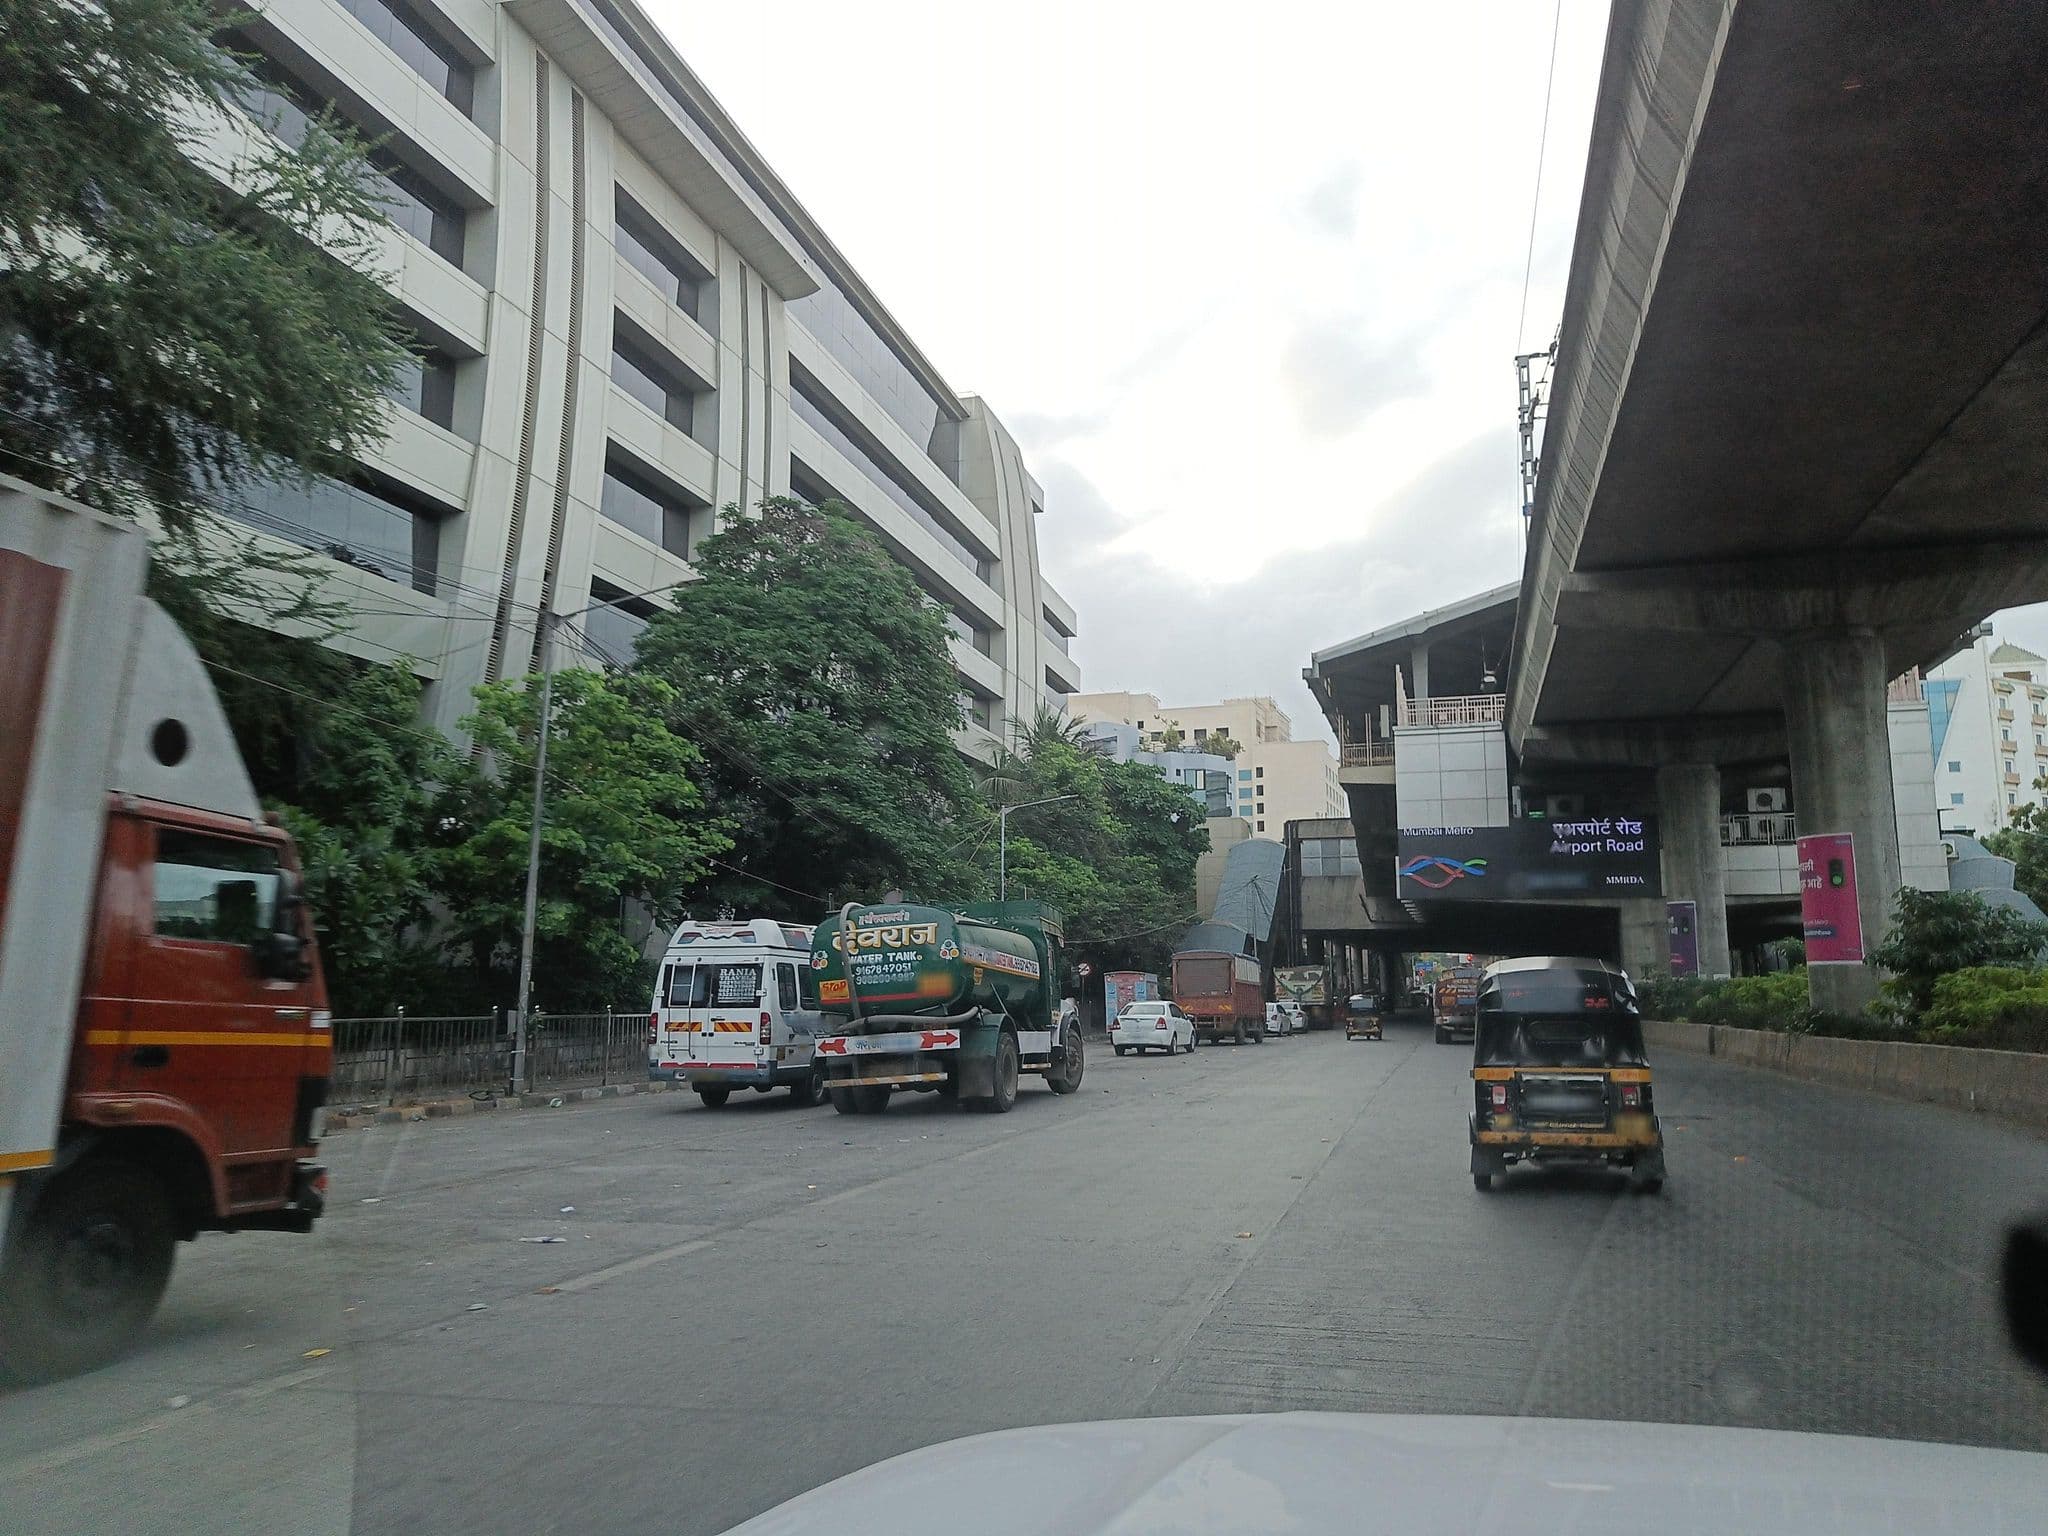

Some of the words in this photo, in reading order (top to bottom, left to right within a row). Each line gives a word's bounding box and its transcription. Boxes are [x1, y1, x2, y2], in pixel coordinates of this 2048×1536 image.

[1403, 826, 1442, 836] Mumbai
[1445, 826, 1474, 835] Metro
[1615, 817, 1642, 834] रोड
[1550, 840, 1602, 856] Airport
[1606, 839, 1644, 852] Road
[1606, 876, 1645, 884] MMRDA
[831, 920, 938, 955] देवराज
[849, 953, 883, 964] WATER
[822, 980, 847, 993] STOP
